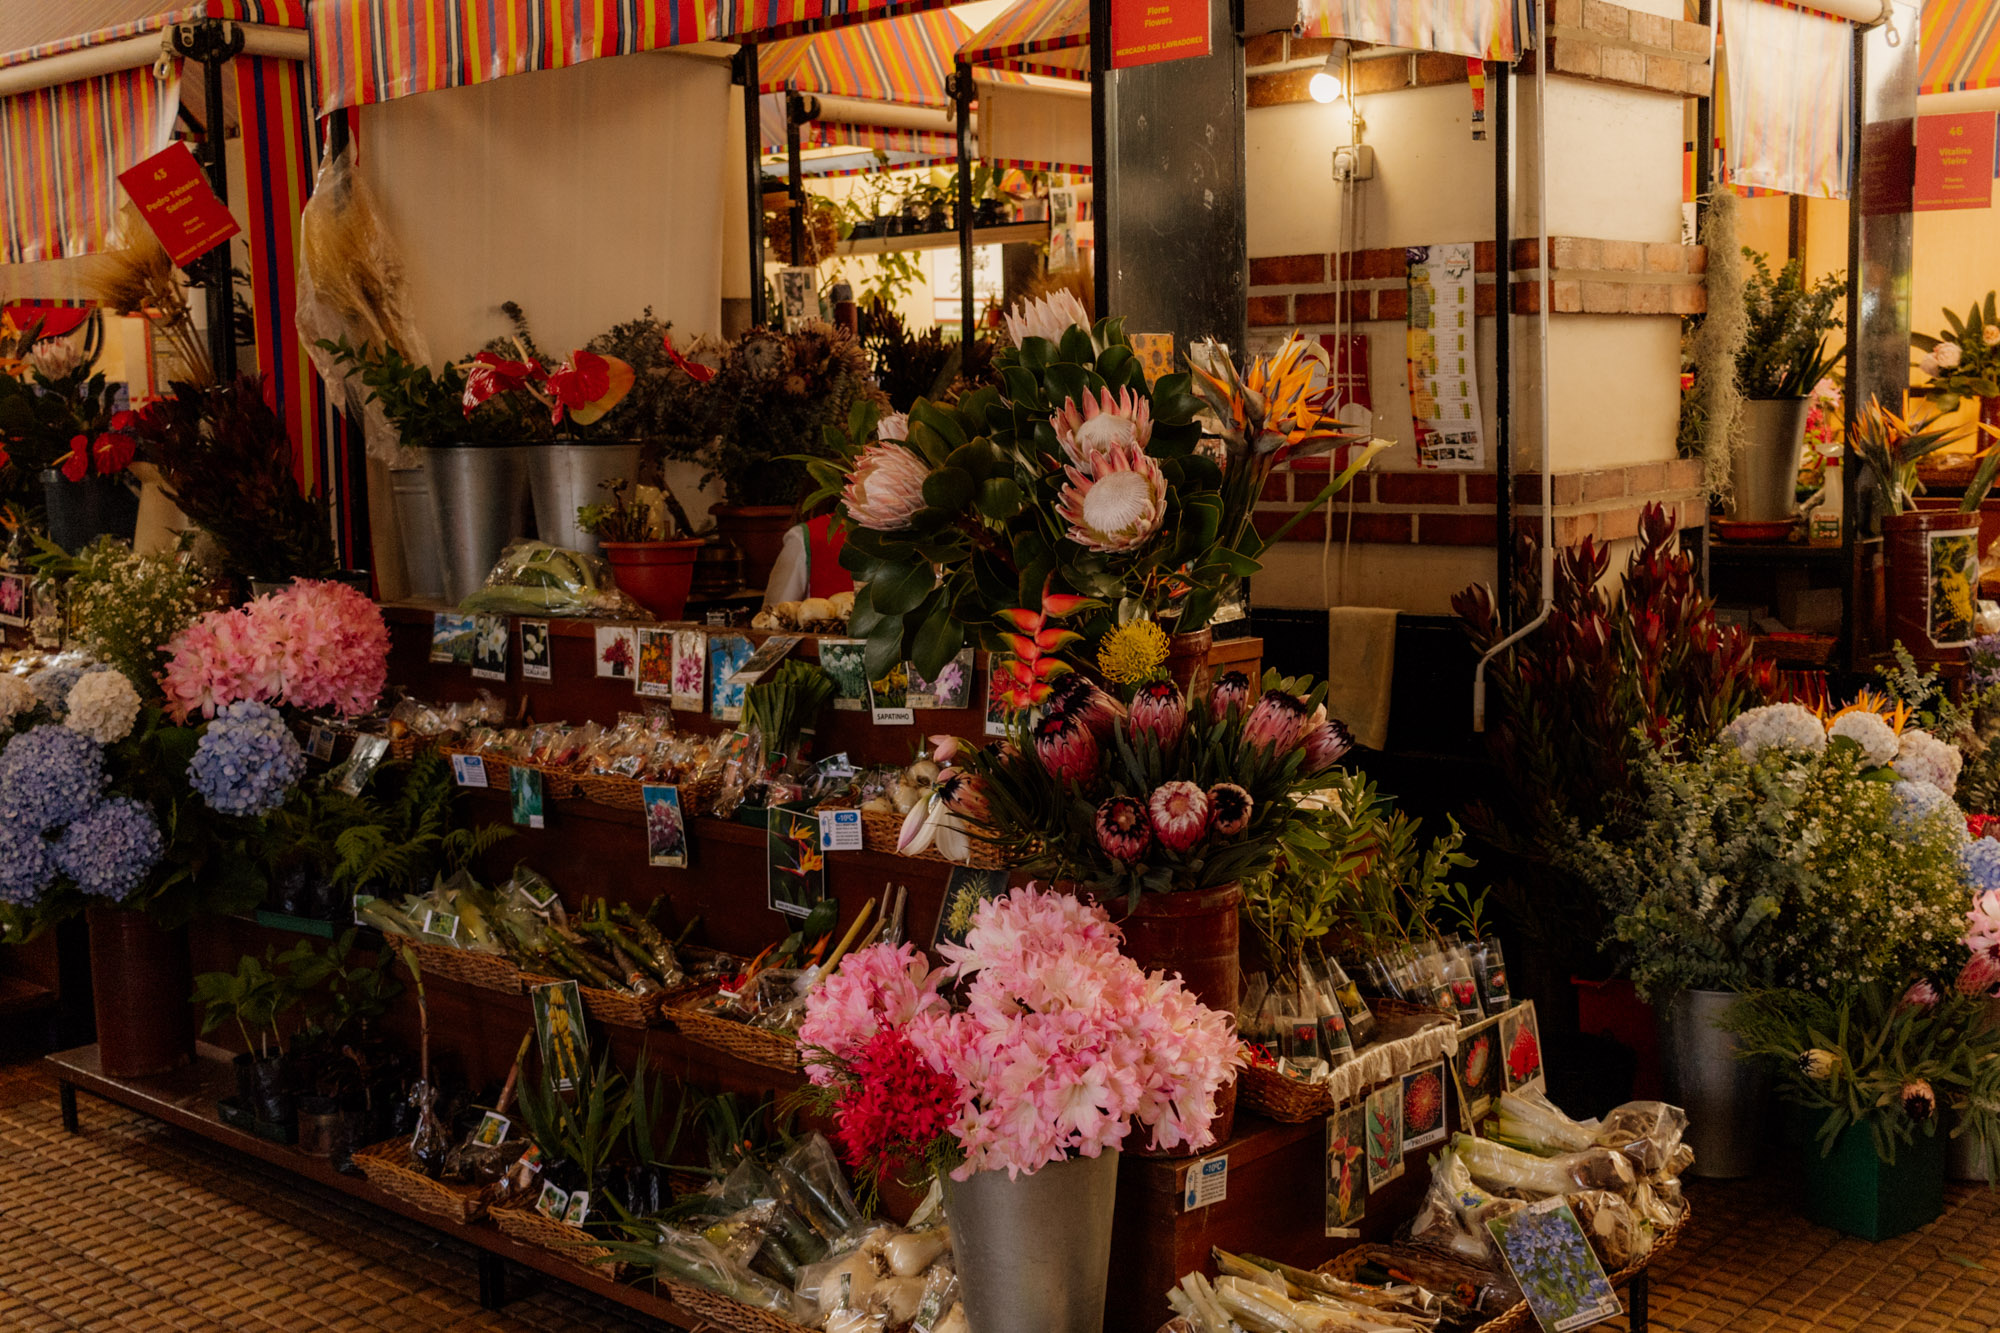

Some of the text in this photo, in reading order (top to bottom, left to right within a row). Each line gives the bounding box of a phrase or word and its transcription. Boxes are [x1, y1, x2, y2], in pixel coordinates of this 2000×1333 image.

[1147, 5, 1170, 16] Flores
[1144, 17, 1173, 28] Flowers
[1116, 35, 1204, 56] MERCADO DOS LAVRADORES
[1939, 147, 1973, 156] Vitalina
[1942, 157, 1968, 165] Vieira
[146, 178, 200, 213] Pedro Teixeira
[166, 195, 193, 214] Santos
[876, 712, 910, 721] SAPATINHO
